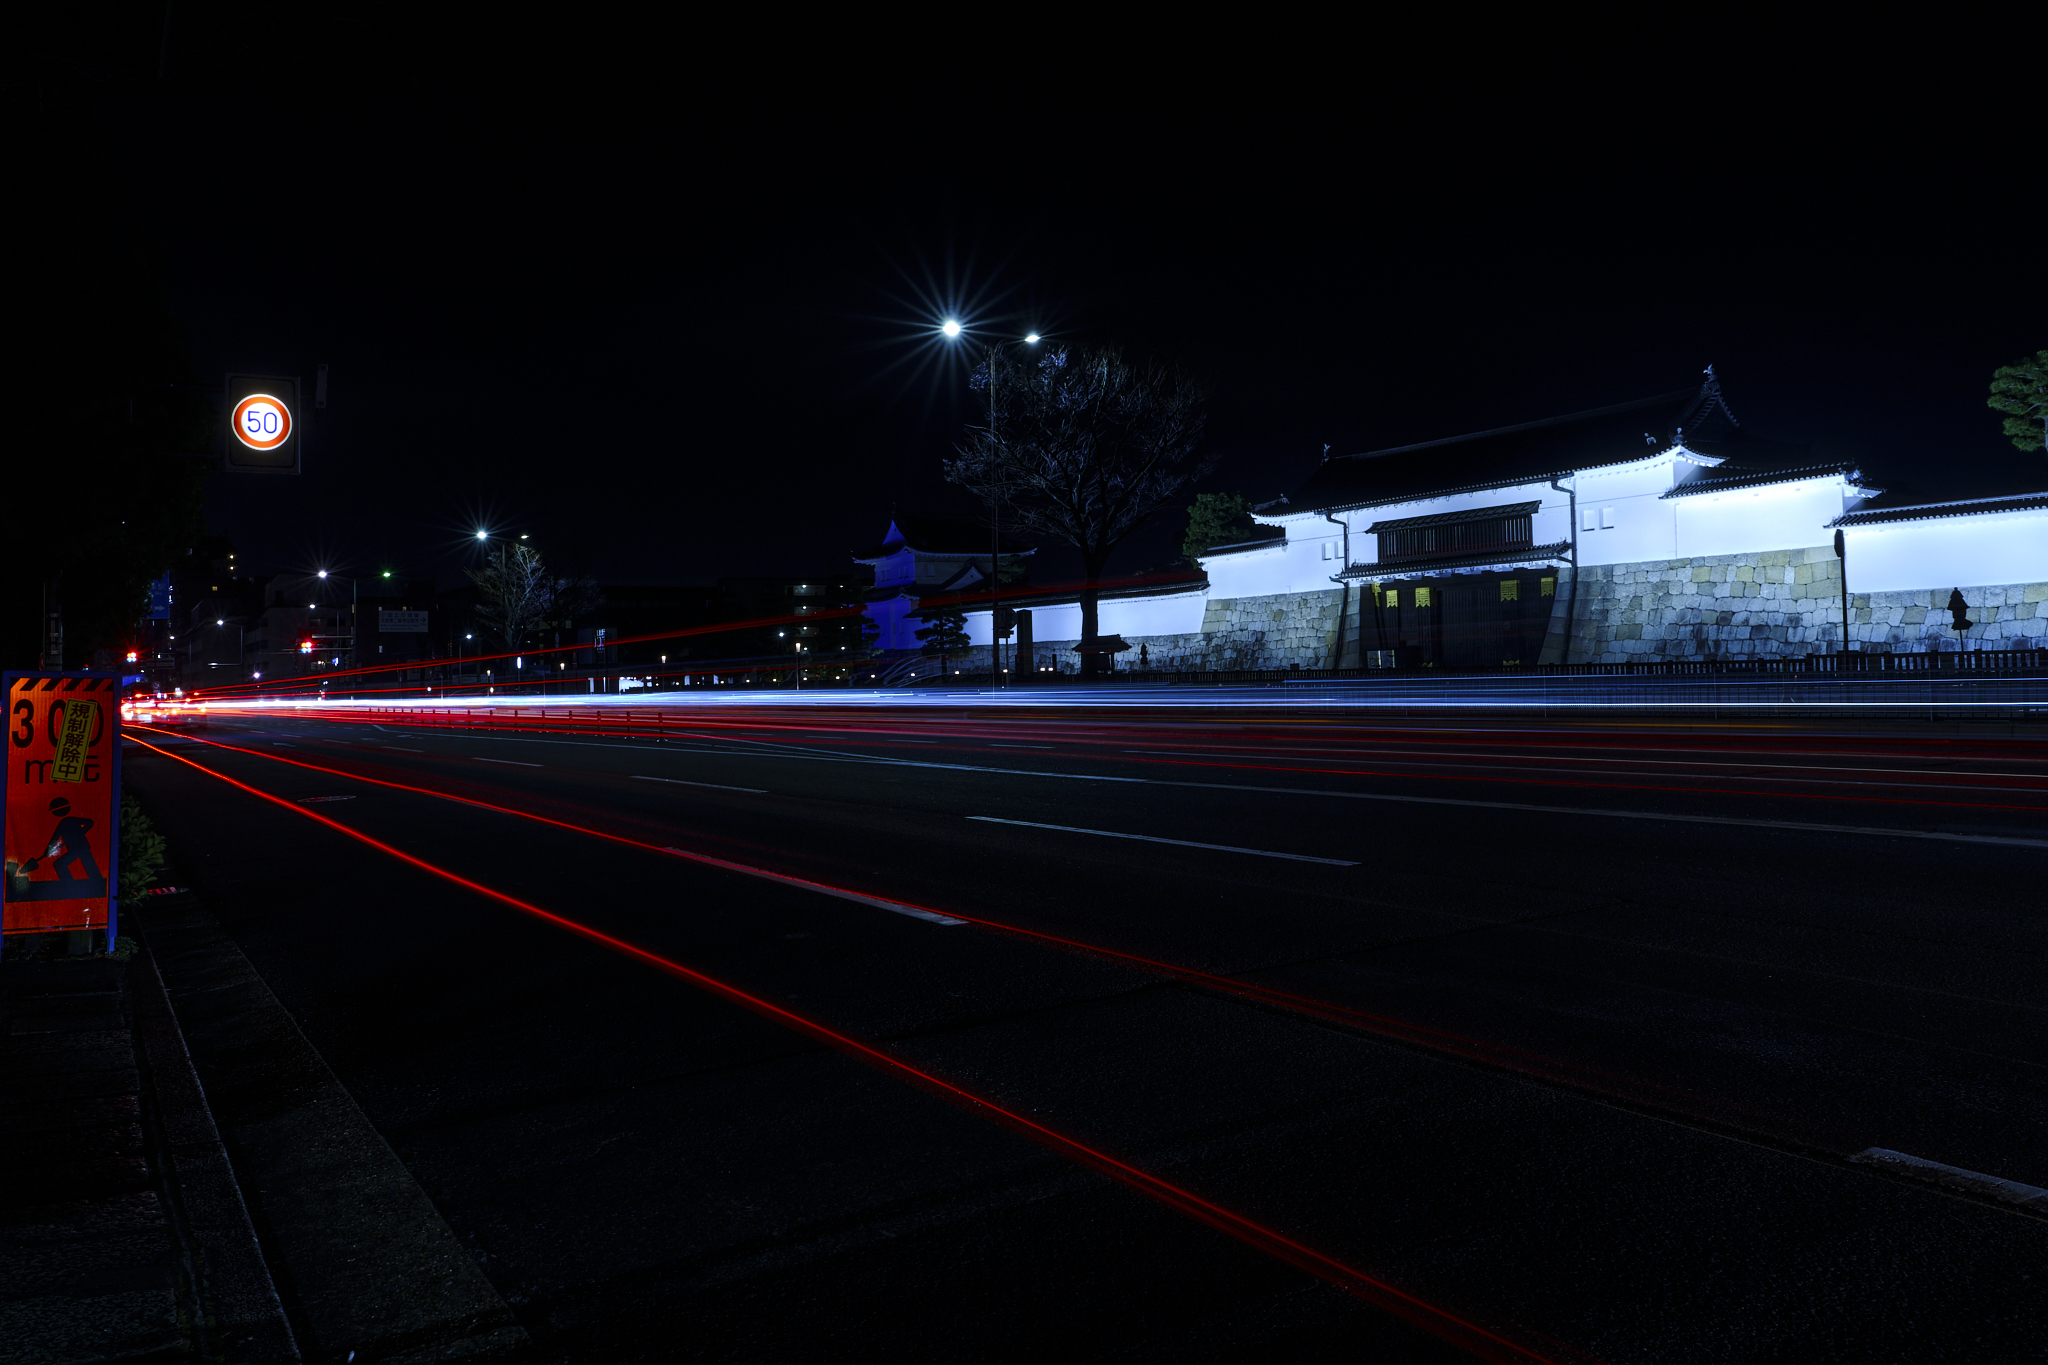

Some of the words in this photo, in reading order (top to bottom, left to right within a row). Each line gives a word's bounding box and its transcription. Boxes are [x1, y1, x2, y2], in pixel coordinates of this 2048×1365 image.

[247, 410, 278, 434] 50
[58, 703, 91, 777] 規制解除中
